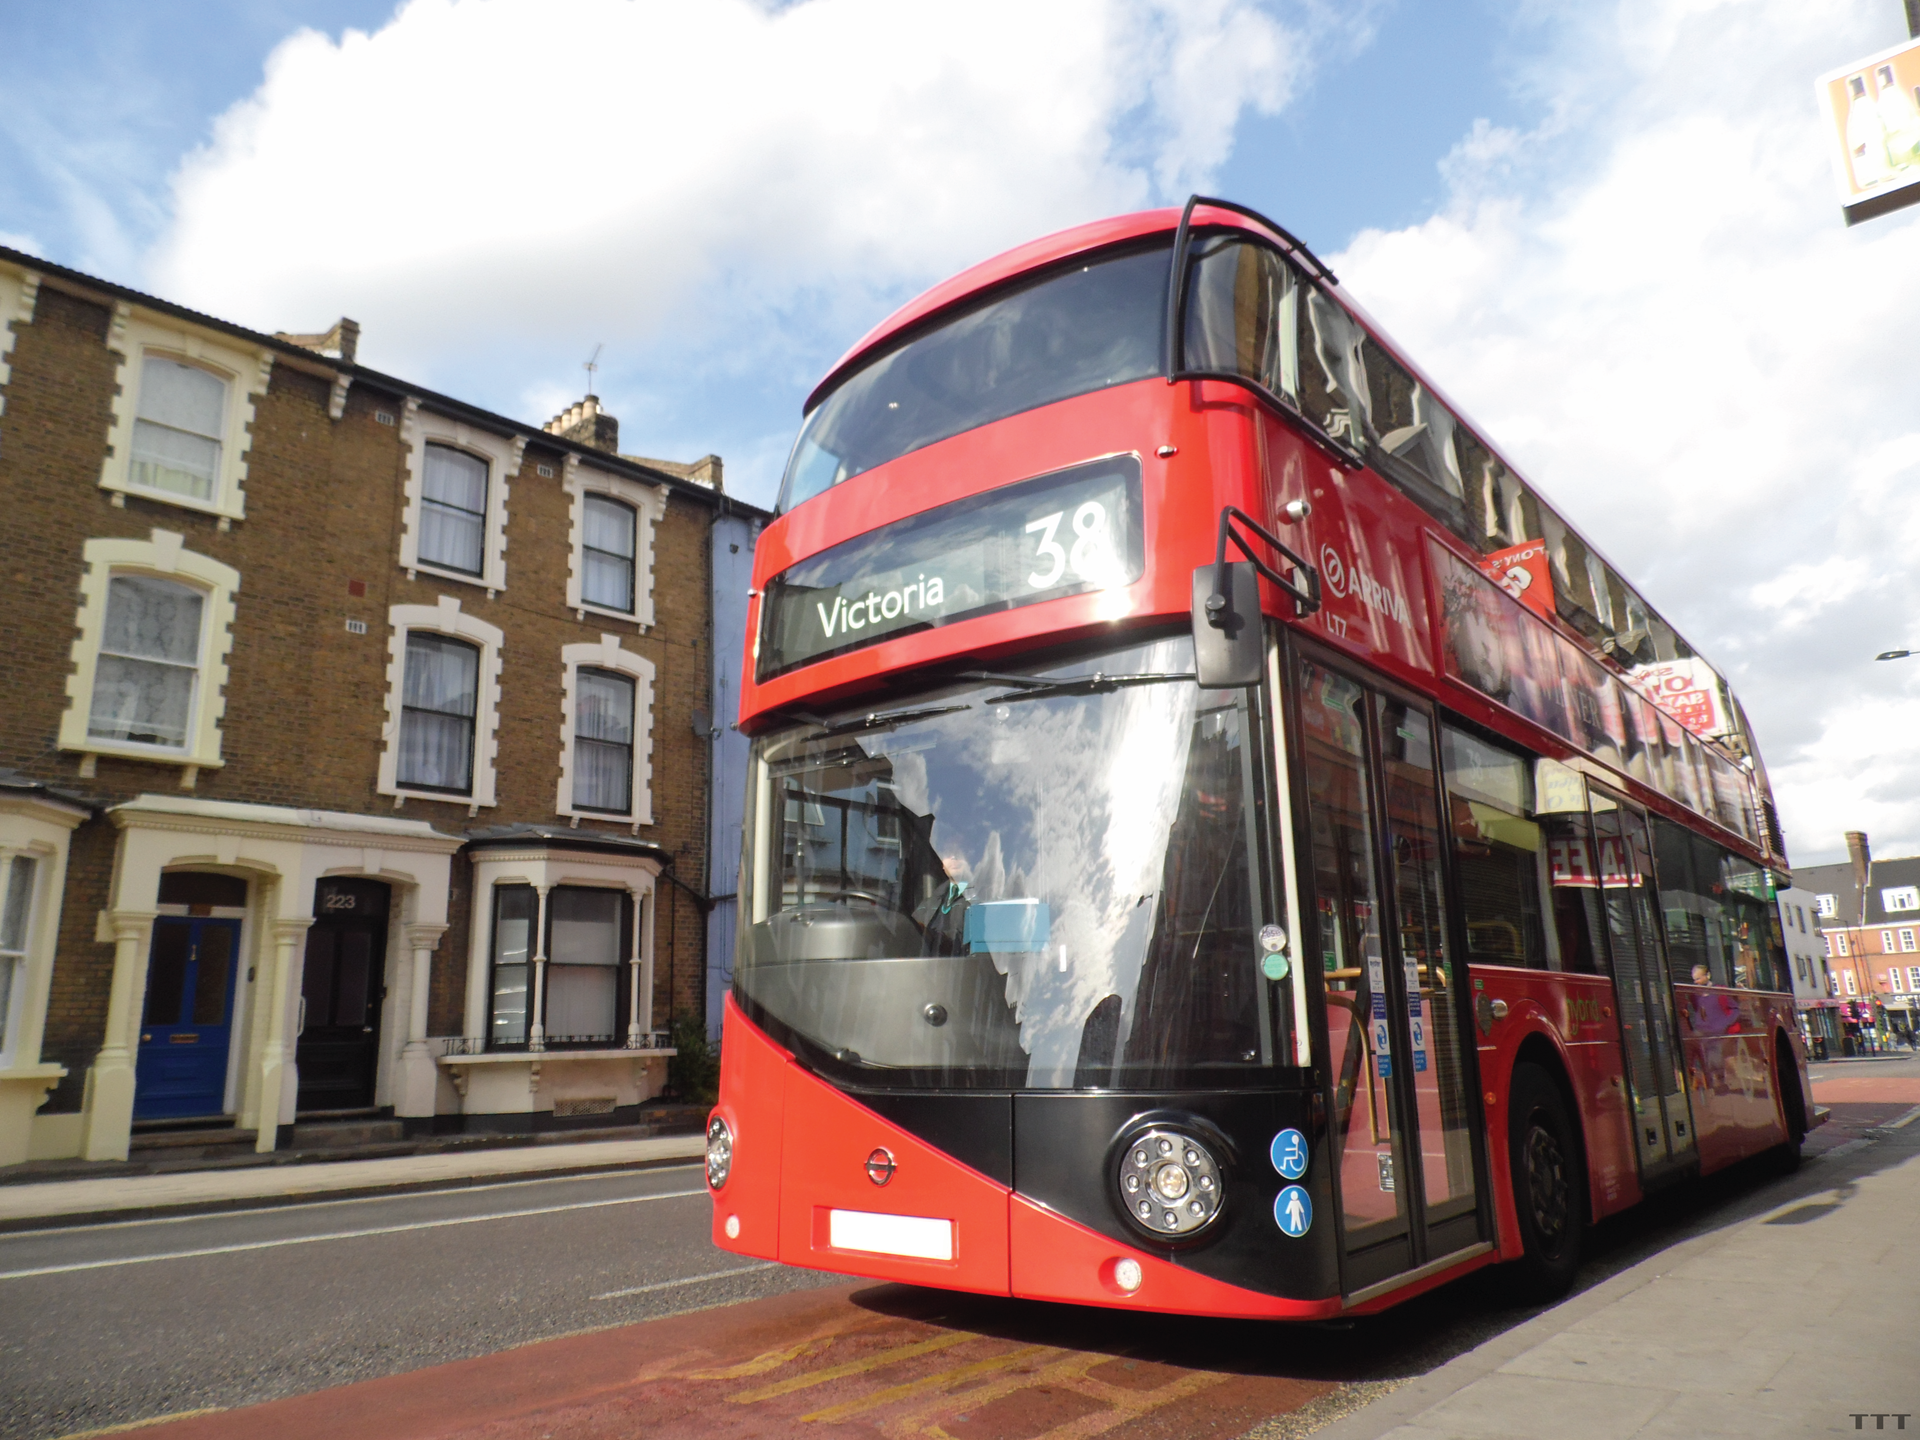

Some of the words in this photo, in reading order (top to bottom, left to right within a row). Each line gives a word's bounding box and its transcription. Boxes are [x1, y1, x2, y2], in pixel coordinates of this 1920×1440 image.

[1025, 501, 1117, 589] 38
[817, 574, 944, 638] Victoria
[1326, 611, 1347, 638] LT7
[1348, 566, 1411, 629] ARRIVA
[326, 894, 356, 909] 223
